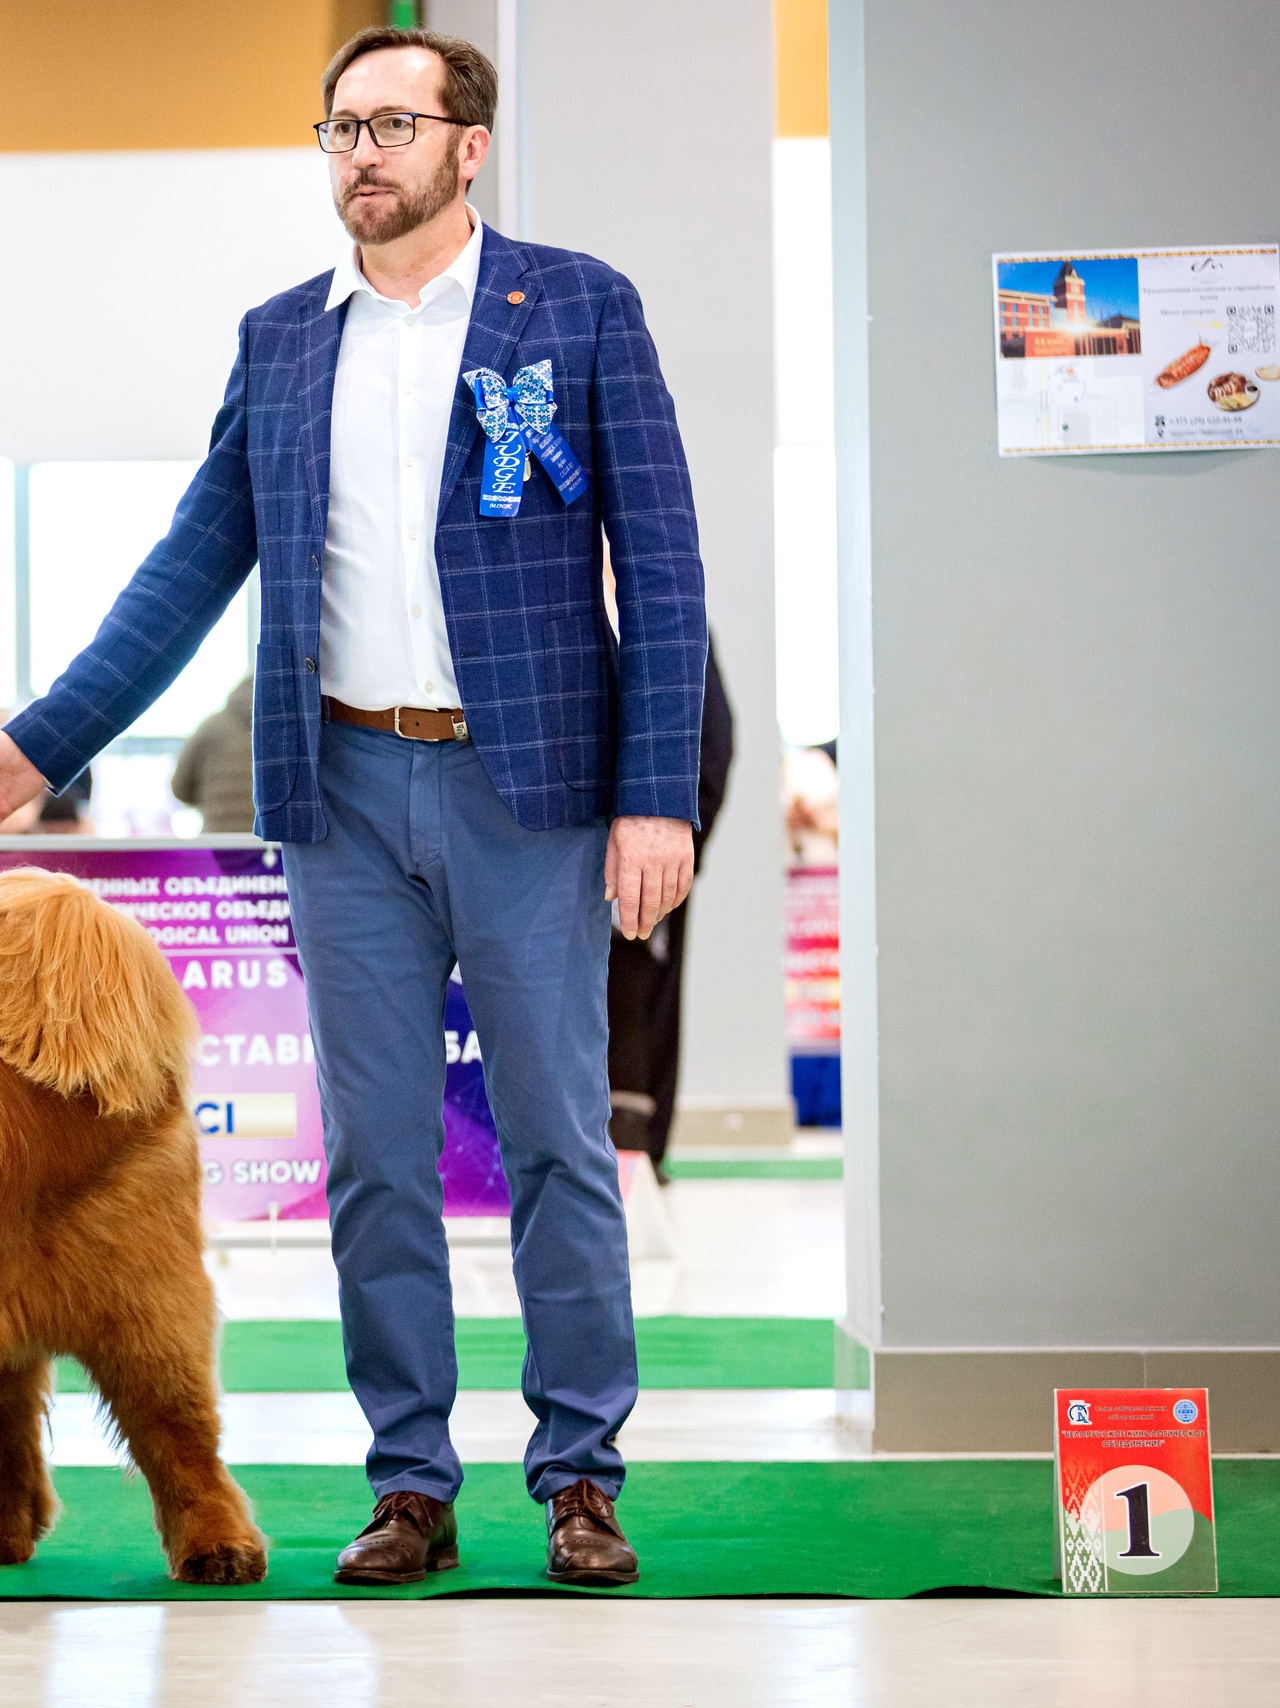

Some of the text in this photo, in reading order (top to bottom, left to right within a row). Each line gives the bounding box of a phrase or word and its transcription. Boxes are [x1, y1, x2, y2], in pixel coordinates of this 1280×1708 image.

[492, 430, 522, 494] JUDGE
[225, 925, 289, 945] UNION
[183, 959, 288, 989] ARUS
[232, 1159, 321, 1184] SHOW
[1127, 1430, 1204, 1438] КИНОЛОГИЧЕСКОЕ
[1115, 1483, 1160, 1557] 1
